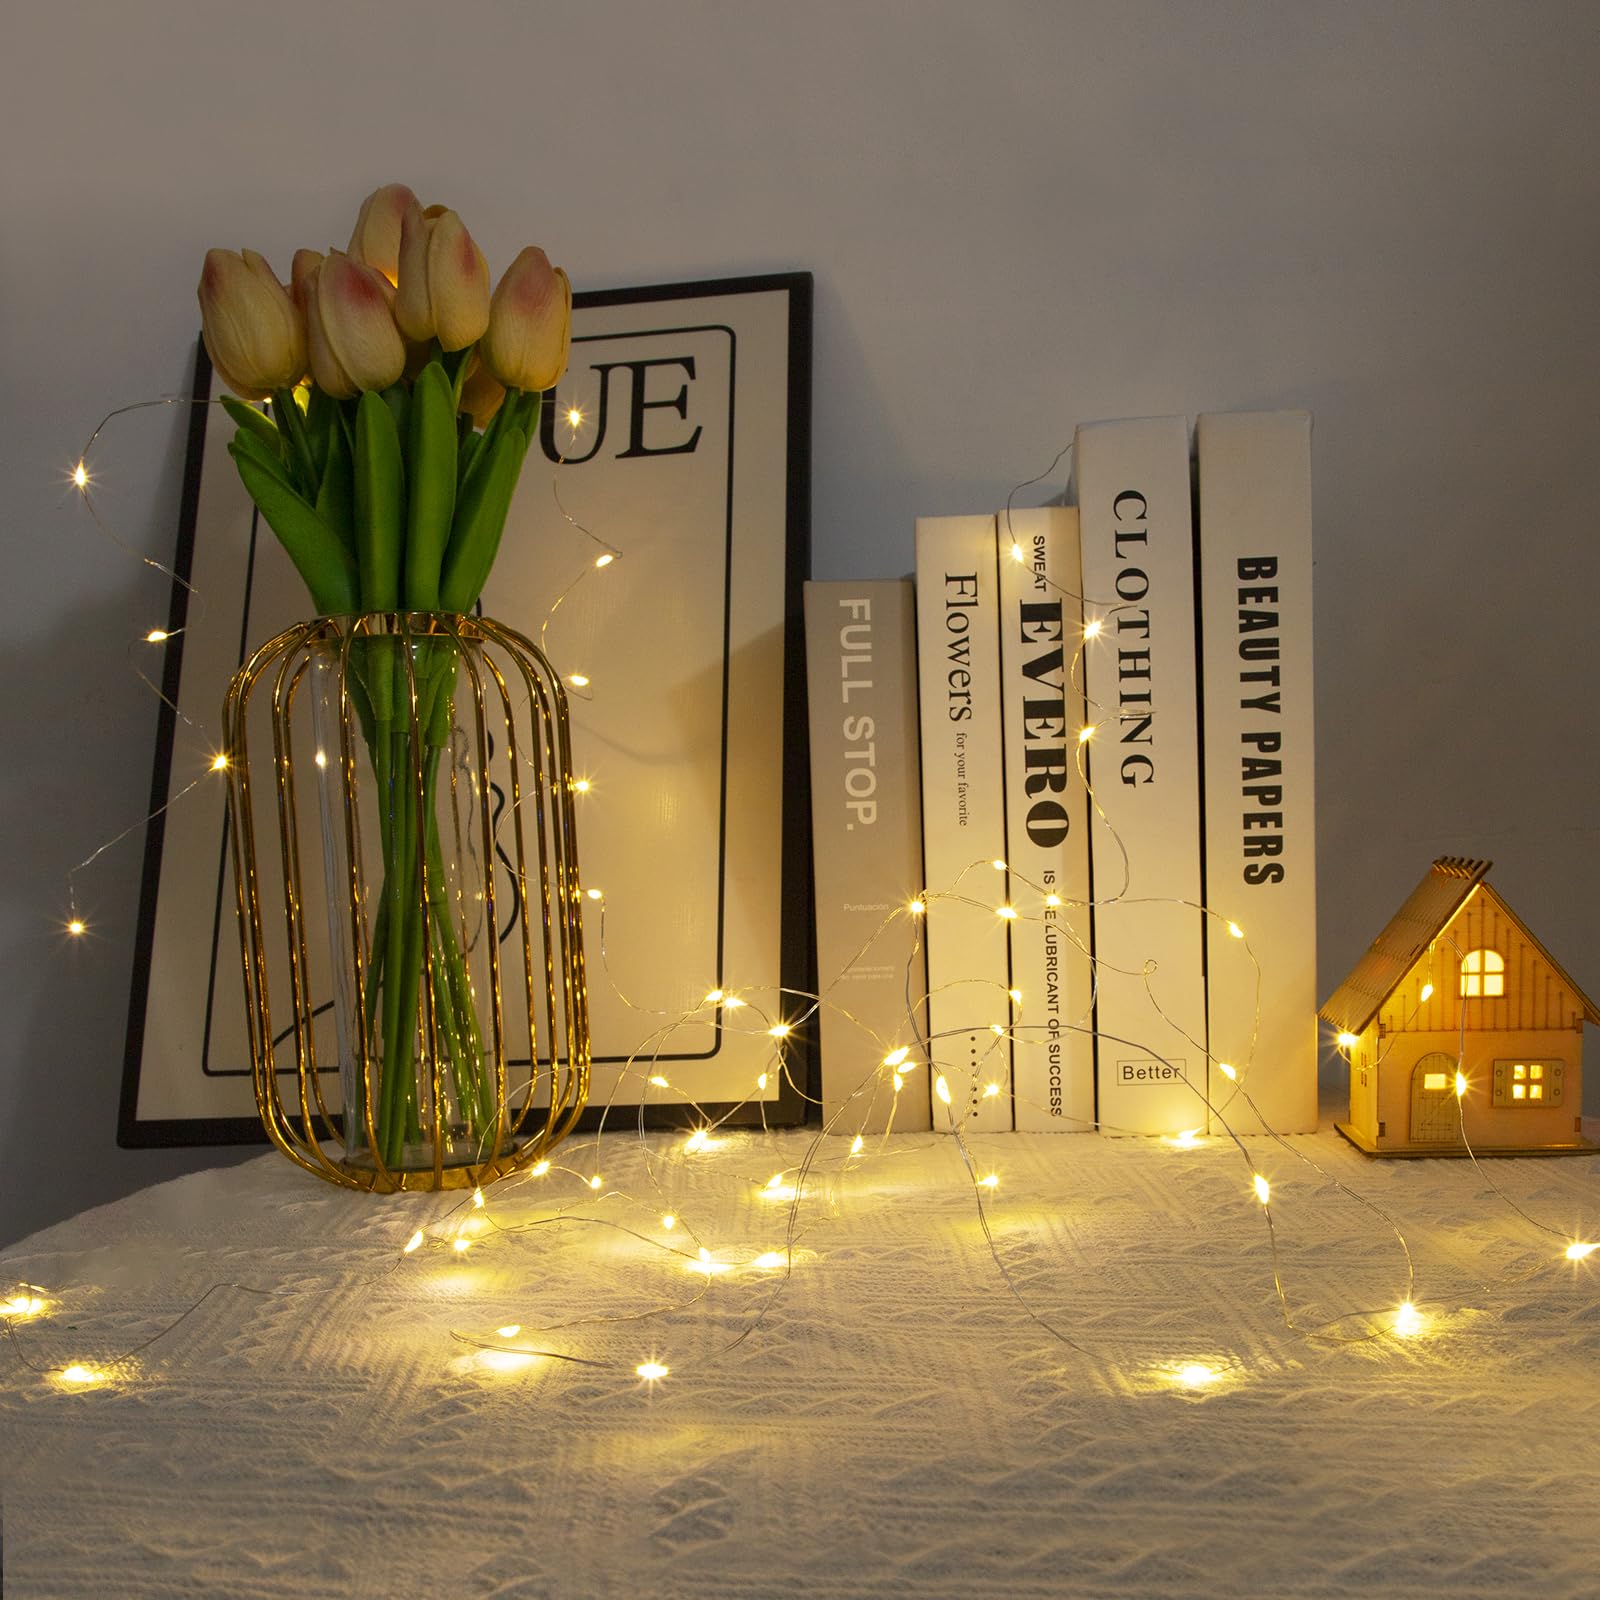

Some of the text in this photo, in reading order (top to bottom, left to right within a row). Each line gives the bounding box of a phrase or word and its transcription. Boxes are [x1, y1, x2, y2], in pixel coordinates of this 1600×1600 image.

[1033, 535, 1047, 592] SWEAT
[1112, 489, 1155, 788] CLOTHING
[839, 598, 878, 832] FULL STOP.
[944, 572, 979, 826] Flowers for your favorite
[1019, 597, 1070, 848] EVERO
[1236, 556, 1285, 886] BEAUTY PAPERS
[1043, 870, 1056, 885] IS
[1045, 924, 1059, 1014] LUBRICANT
[1047, 1018, 1060, 1040] OF
[1122, 1065, 1180, 1080] Better
[1048, 1044, 1062, 1117] SUCCESS
